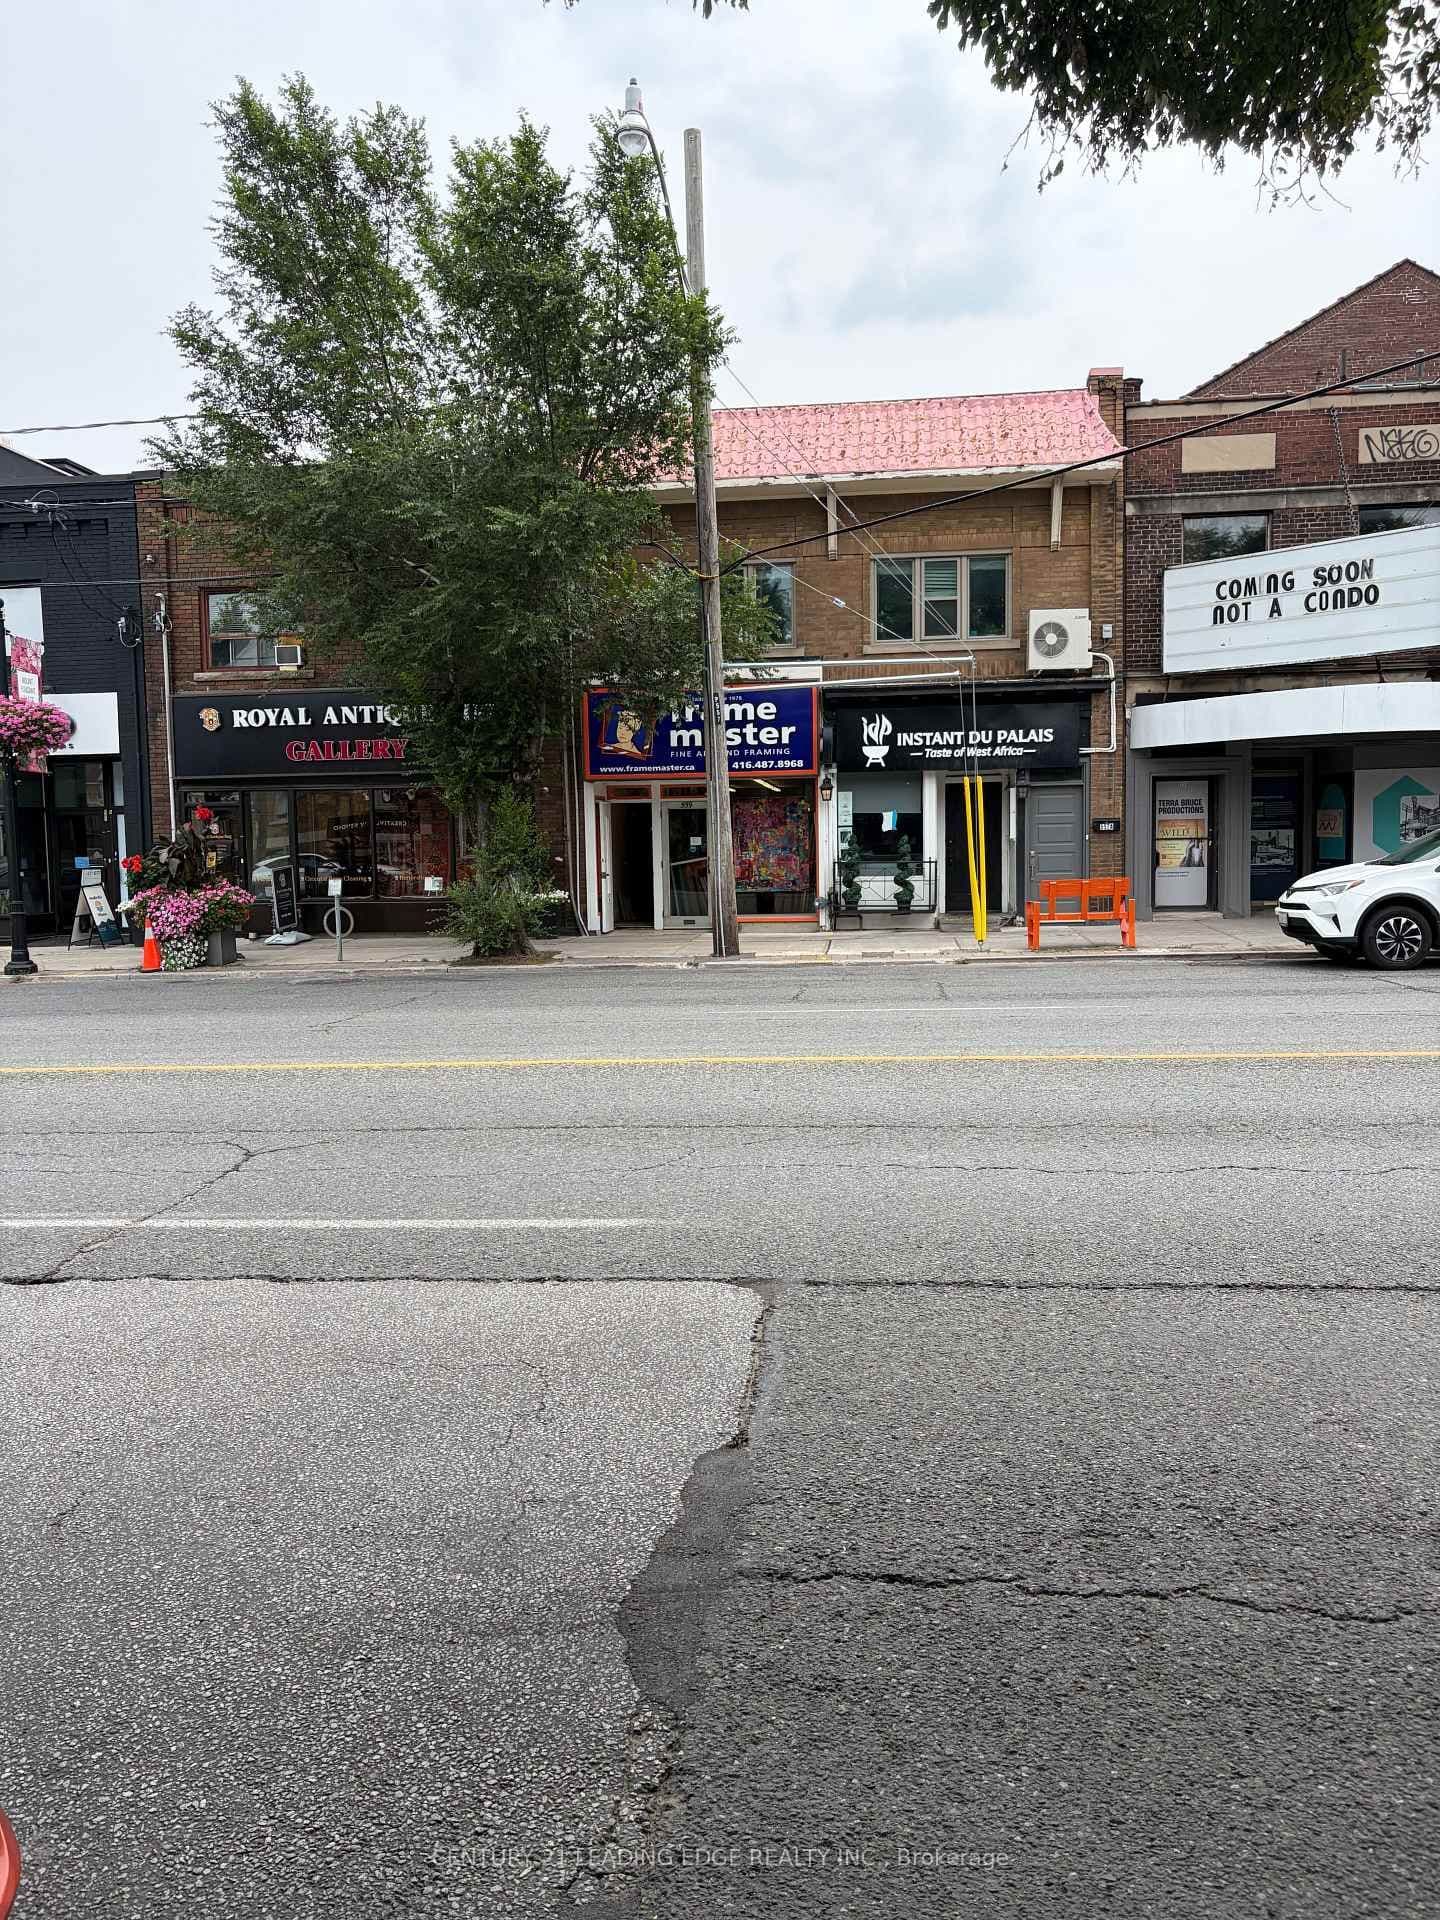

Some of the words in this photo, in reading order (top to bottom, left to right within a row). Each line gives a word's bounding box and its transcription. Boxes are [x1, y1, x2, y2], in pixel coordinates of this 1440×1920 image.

[1215, 571, 1295, 601] COMING
[1312, 558, 1375, 588] SOON
[1212, 601, 1252, 625] NOT
[1269, 597, 1283, 618] A
[1304, 584, 1380, 613] CONDO
[232, 706, 312, 728] ROYAL
[670, 698, 777, 723] rme
[669, 722, 796, 747] mster
[896, 731, 965, 747] INSTANT
[968, 730, 993, 745] DU
[997, 728, 1054, 743] PALAIS
[285, 738, 409, 762] GALLERY
[670, 750, 692, 758] FINE
[744, 747, 791, 756] FRAMING
[924, 747, 953, 758] Taste
[953, 747, 966, 757] of
[966, 746, 992, 757] West
[992, 745, 1024, 756] Africa
[600, 764, 696, 773] www.framemaster.ca
[732, 759, 804, 770] 416.487.8968
[1158, 799, 1179, 807] TERRA
[1158, 806, 1205, 815] PRODUCTIONS
